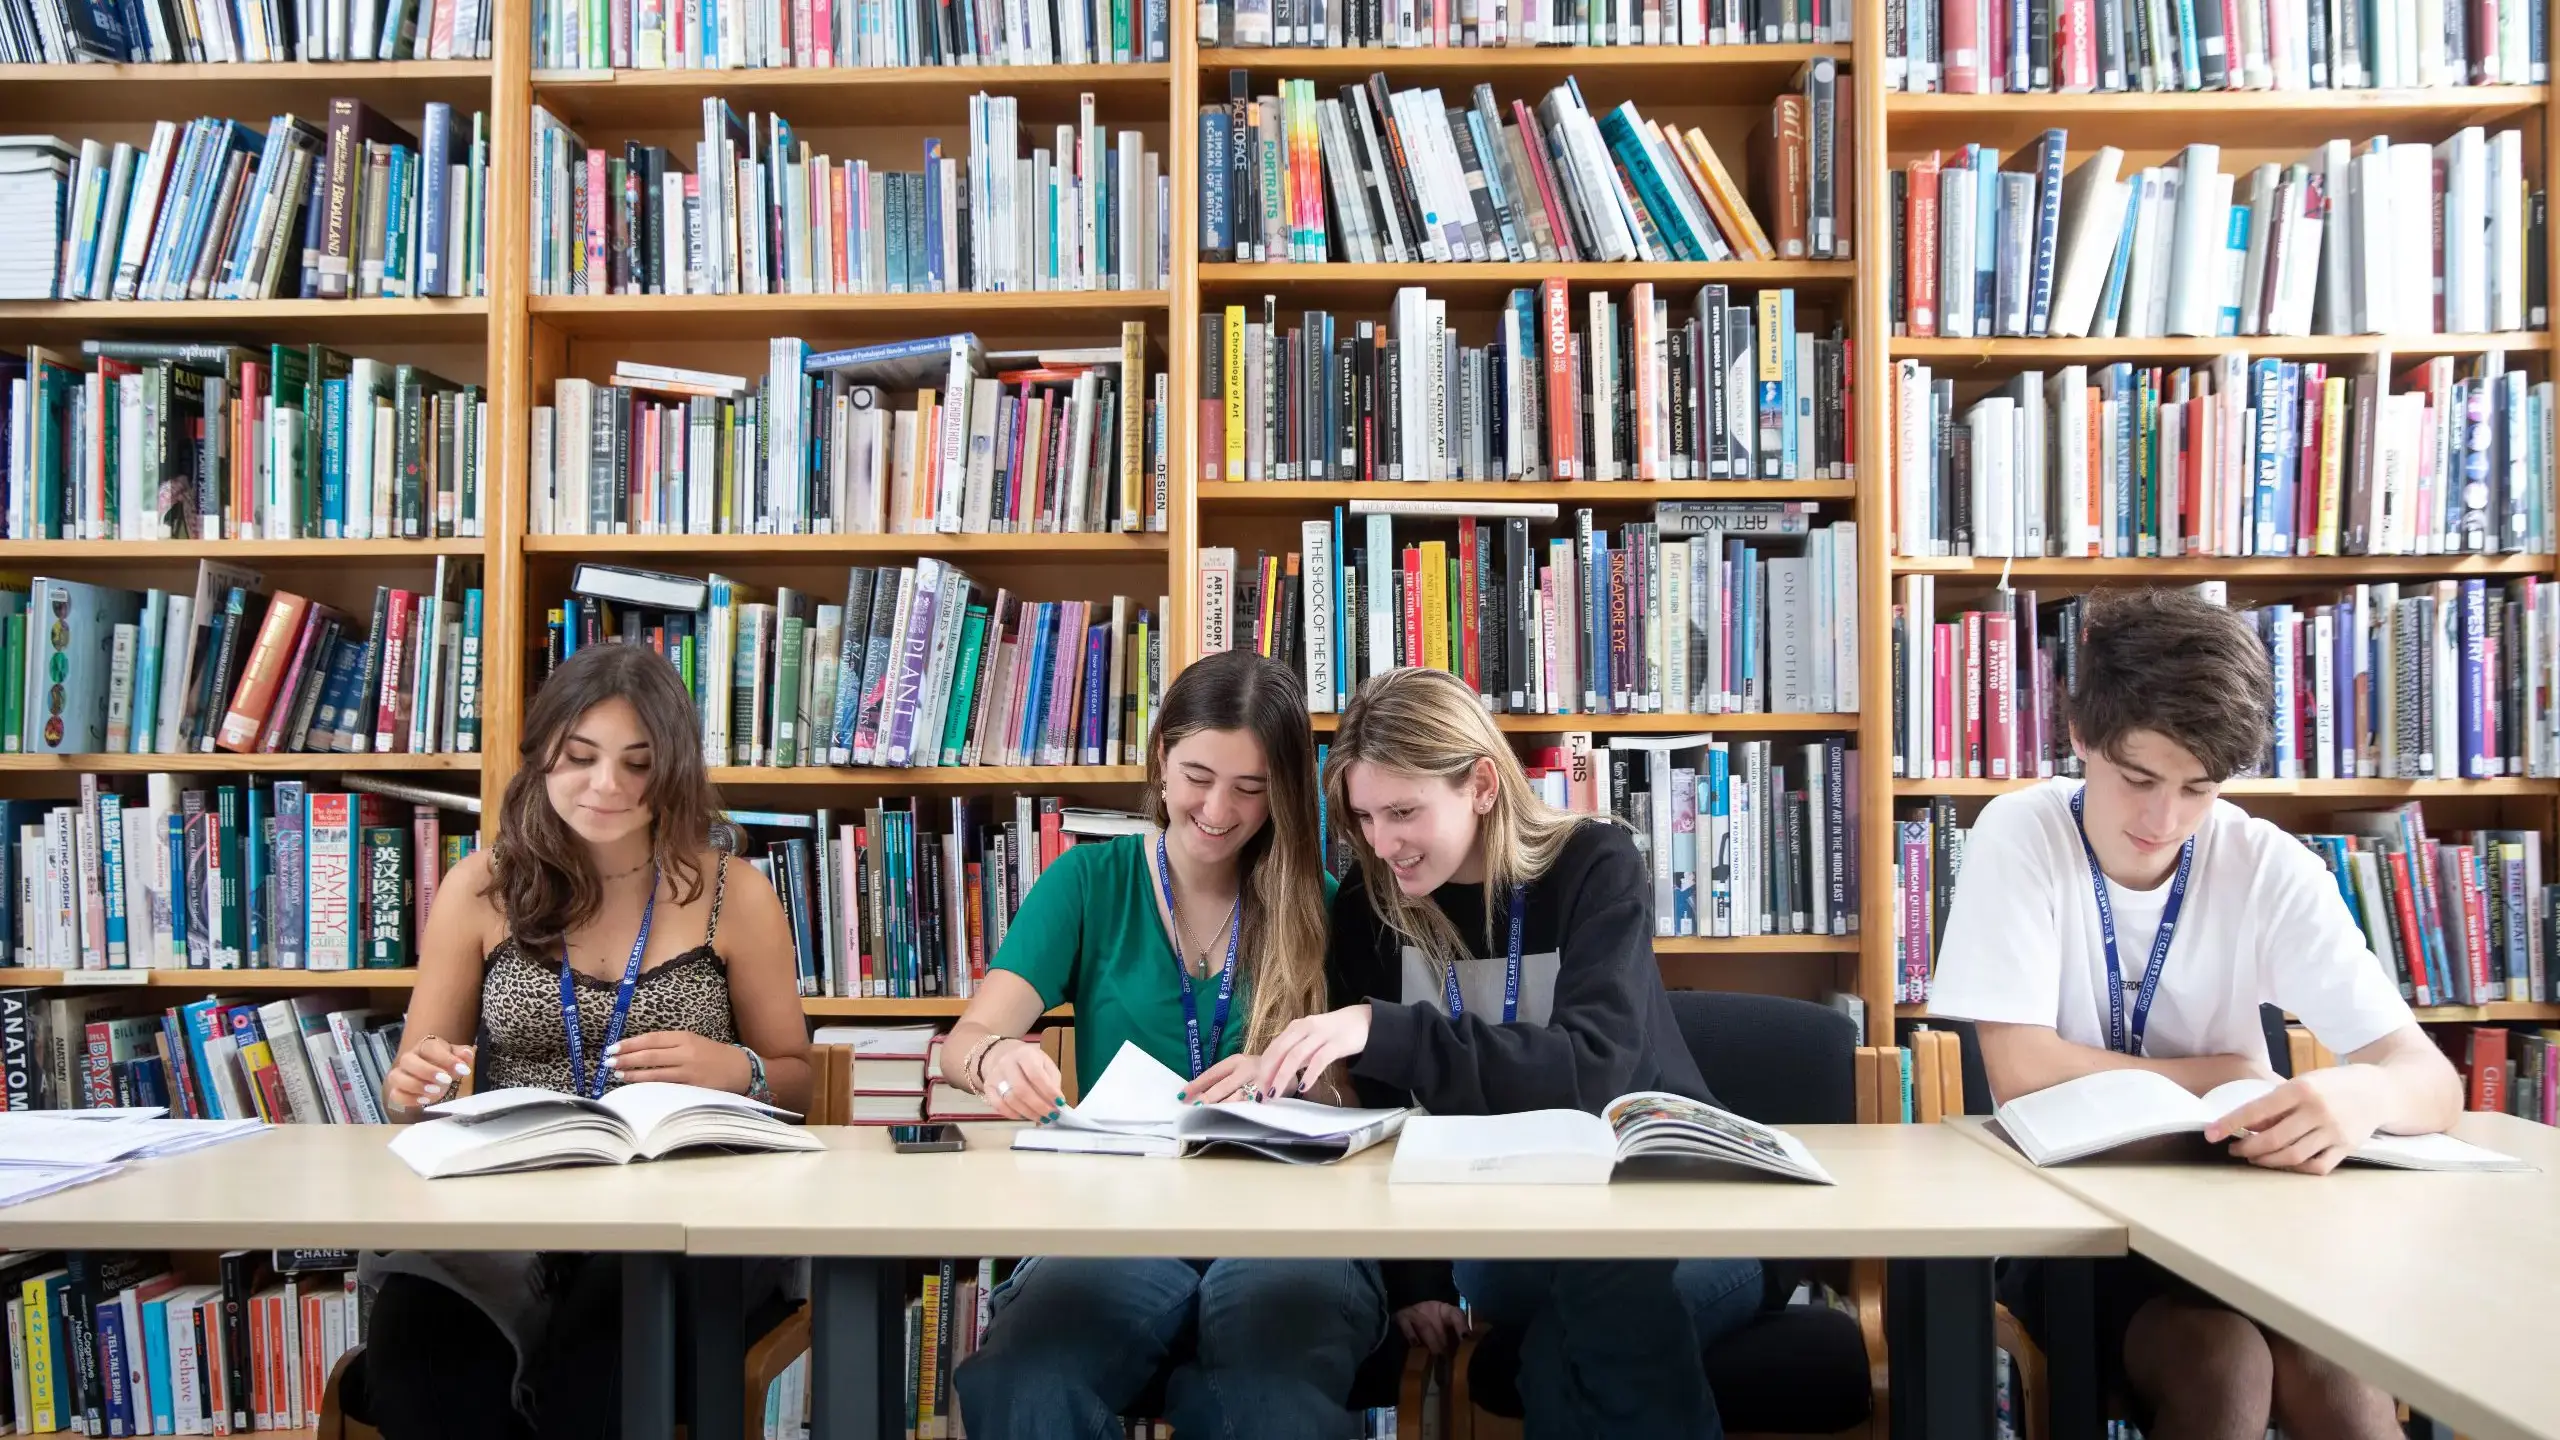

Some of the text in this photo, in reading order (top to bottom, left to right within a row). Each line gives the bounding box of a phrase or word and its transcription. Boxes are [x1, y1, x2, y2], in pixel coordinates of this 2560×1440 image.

[1206, 120, 1214, 167] SCHAMA
[1783, 100, 1804, 141] art
[1214, 131, 1222, 167] SIMON
[1206, 173, 1214, 231] OF BRITAIN
[1264, 140, 1278, 219] PORTRAITS
[328, 184, 345, 256] BROADLAND
[2037, 149, 2062, 309] HEARST CASTLE
[387, 231, 398, 268] Pollution
[1551, 288, 1566, 355] MÉXICO
[1712, 306, 1720, 333] STYLES,
[1231, 331, 1240, 386] Chronology
[1436, 316, 1444, 381] NINETEENTH
[1713, 334, 1721, 368] SCHOOLS
[160, 366, 168, 422] PLANTWATCHING
[1232, 389, 1240, 399] of
[1831, 354, 1839, 409] Performance Art
[946, 386, 960, 461] PSYCHOPATHOLOGY
[1125, 368, 1140, 476] ENGINEERS
[1232, 403, 1240, 418] Art
[1715, 388, 1723, 435] MOVEMENTS
[2260, 370, 2279, 490] ANIMATION ART
[601, 425, 609, 452] NERVES
[1437, 437, 1445, 459] ART
[2118, 390, 2130, 517] FACIAL EXPRESSION
[1680, 515, 1768, 530] ART NOW
[1214, 576, 1223, 596] ART
[1479, 540, 1488, 607] installation art
[1543, 578, 1551, 598] ART
[939, 576, 955, 630] VEGETABLES
[1214, 607, 1222, 647] THEORY
[1310, 538, 1327, 695] THE SHOCK OF THE NEW
[1612, 553, 1626, 653] SINGAPORE EYE
[2467, 588, 2484, 663] TAPESTRY
[2488, 597, 2502, 655] Fashion
[548, 629, 556, 668] Alternative
[1544, 610, 1556, 660] OUTRAGE
[1783, 572, 1797, 702] ONE AND OTHER
[380, 639, 393, 706] AMPHIBIANS
[388, 639, 401, 712] REPTILES AND
[459, 636, 478, 719] BIRDS
[860, 639, 877, 725] GARDEN PLANTS
[895, 638, 925, 722] PLANT
[1091, 679, 1097, 688] Go
[1150, 639, 1160, 682] Nigel Slater
[1989, 640, 1998, 690] OF TATTOO
[1999, 640, 2008, 723] THE WORLD ATLAS
[102, 799, 112, 851] CHANGED
[1007, 827, 1018, 865] FIREWORKS
[1789, 805, 1799, 855] INDIAN ART
[1831, 746, 1843, 903] CONTEMPORARY ART IN THE MIDDLE EAST
[60, 813, 70, 909] INVENTING MODERN
[109, 799, 123, 918] THE DAY THE UNIVERSE
[311, 853, 327, 935] HEALTH
[327, 853, 347, 936] FAMILY
[1909, 849, 1920, 961] AMERICAN QUILTS SHAW
[2510, 863, 2524, 953] STREET CRAFT
[2104, 925, 2112, 934] ST
[2162, 931, 2171, 942] ST
[1507, 986, 1514, 994] ST
[1511, 917, 1519, 953] OXFORD
[1450, 977, 1461, 1011] OXFORD
[2109, 971, 2119, 1006] OXFORD
[2139, 976, 2156, 1012] OXFORD
[3, 997, 28, 1111] ANATOM
[56, 1037, 66, 1082] ANATOMY
[1191, 1028, 1202, 1071] ST CLARE'S
[2113, 1037, 2121, 1046] ST
[356, 1075, 369, 1103] PLEASURE
[294, 1249, 348, 1259] CHANEL
[926, 1283, 939, 1298] MY
[941, 1264, 950, 1300] CRYSTAL
[924, 1320, 937, 1334] AS
[925, 1300, 939, 1319] LIFE
[939, 1309, 948, 1345] DRAGON
[75, 1321, 88, 1391] Neuroscience
[84, 1331, 95, 1378] Cognitive
[108, 1334, 122, 1405] TELL-TALE BRAIN
[178, 1347, 194, 1402] Behave
[923, 1345, 936, 1371] WORK
[920, 1388, 933, 1407] ART
[921, 1375, 934, 1388] OF
